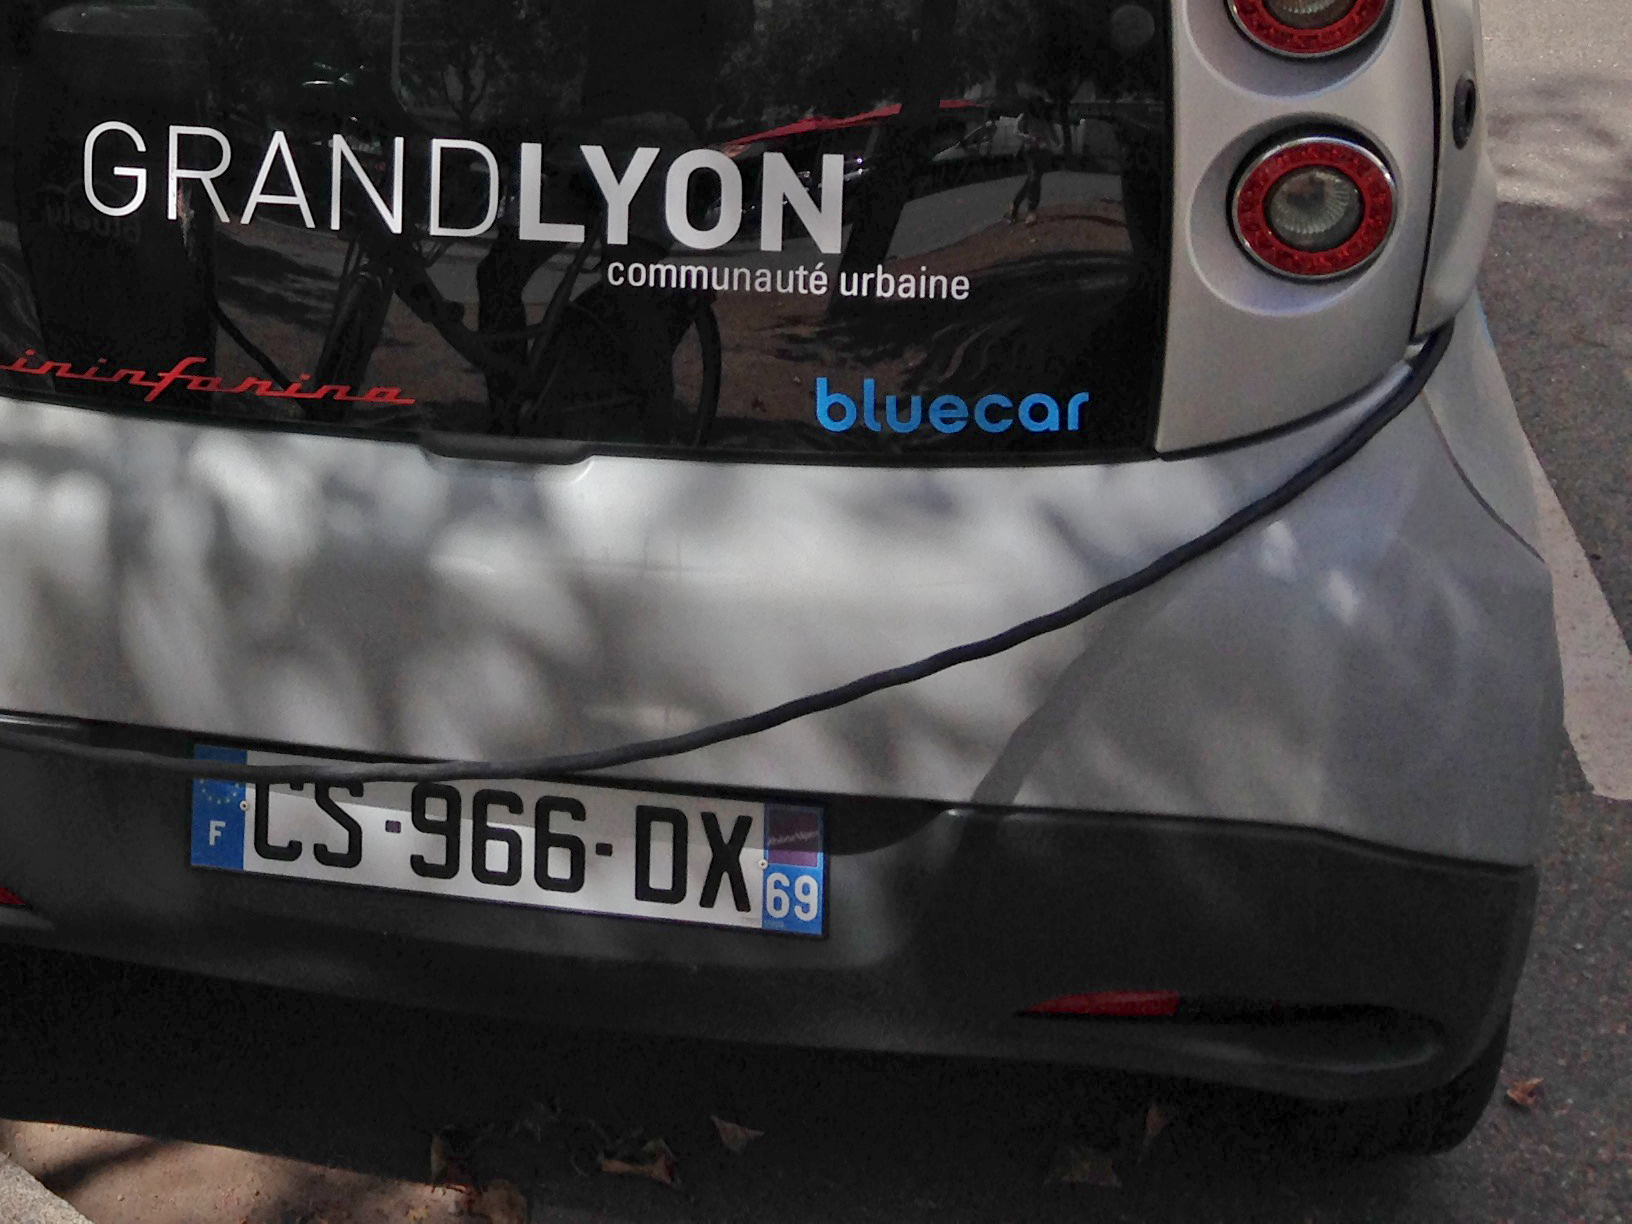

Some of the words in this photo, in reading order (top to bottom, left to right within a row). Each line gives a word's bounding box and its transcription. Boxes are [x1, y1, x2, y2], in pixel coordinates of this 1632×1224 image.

[84, 120, 845, 254] GRANDLYON
[607, 259, 829, 296] communauté
[839, 265, 970, 300] urbaine
[815, 377, 1090, 433] bluecar
[208, 819, 227, 847] F
[254, 778, 753, 914] CS-966-DX
[766, 872, 819, 922] 69
